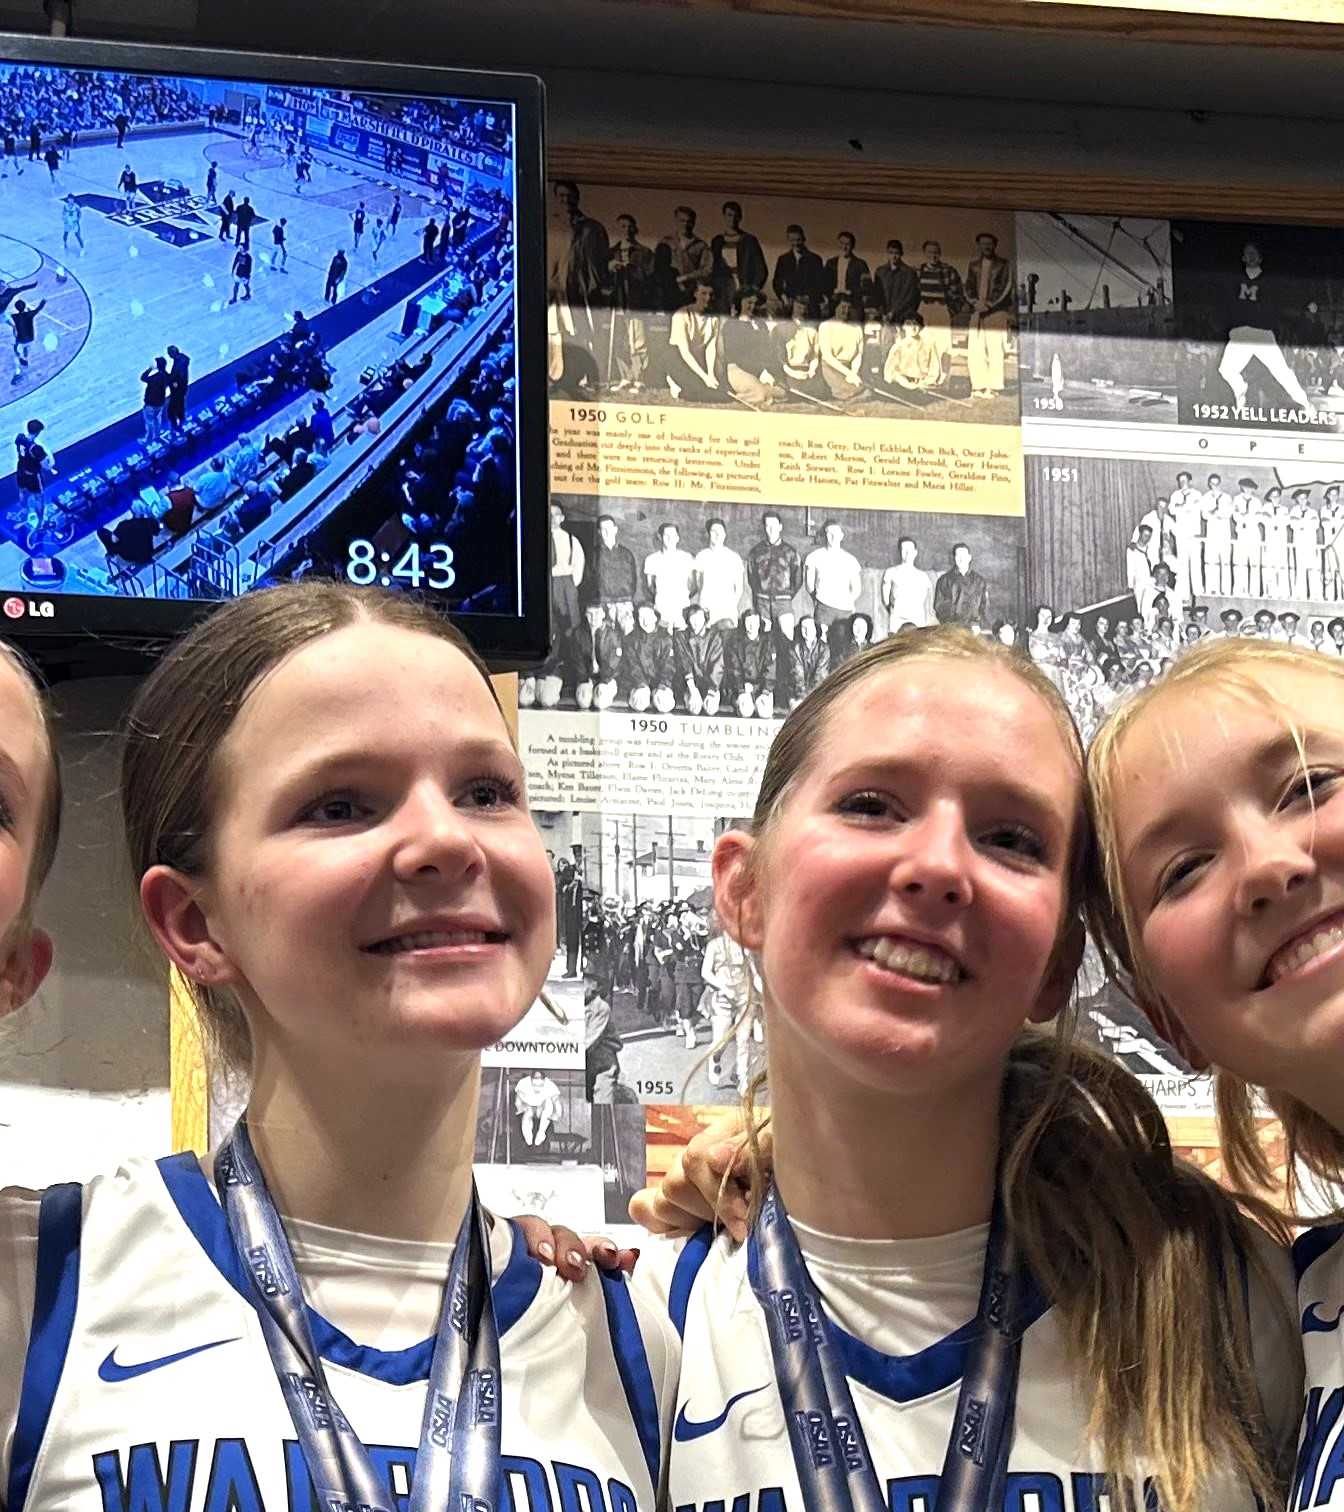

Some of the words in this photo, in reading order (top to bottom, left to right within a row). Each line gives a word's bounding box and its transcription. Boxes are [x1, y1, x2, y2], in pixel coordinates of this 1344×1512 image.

[570, 408, 607, 422] 1950
[616, 411, 667, 425] GOLF
[1192, 404, 1230, 420] 1952
[1231, 406, 1268, 422] YELL
[1269, 408, 1338, 426] LEADERS
[1041, 467, 1080, 482] 1951
[344, 540, 456, 589] 8:43
[29, 600, 54, 618] LG
[630, 719, 669, 733] 1950
[494, 1040, 579, 1055] DOWNTOWN
[634, 1080, 674, 1096] 1955
